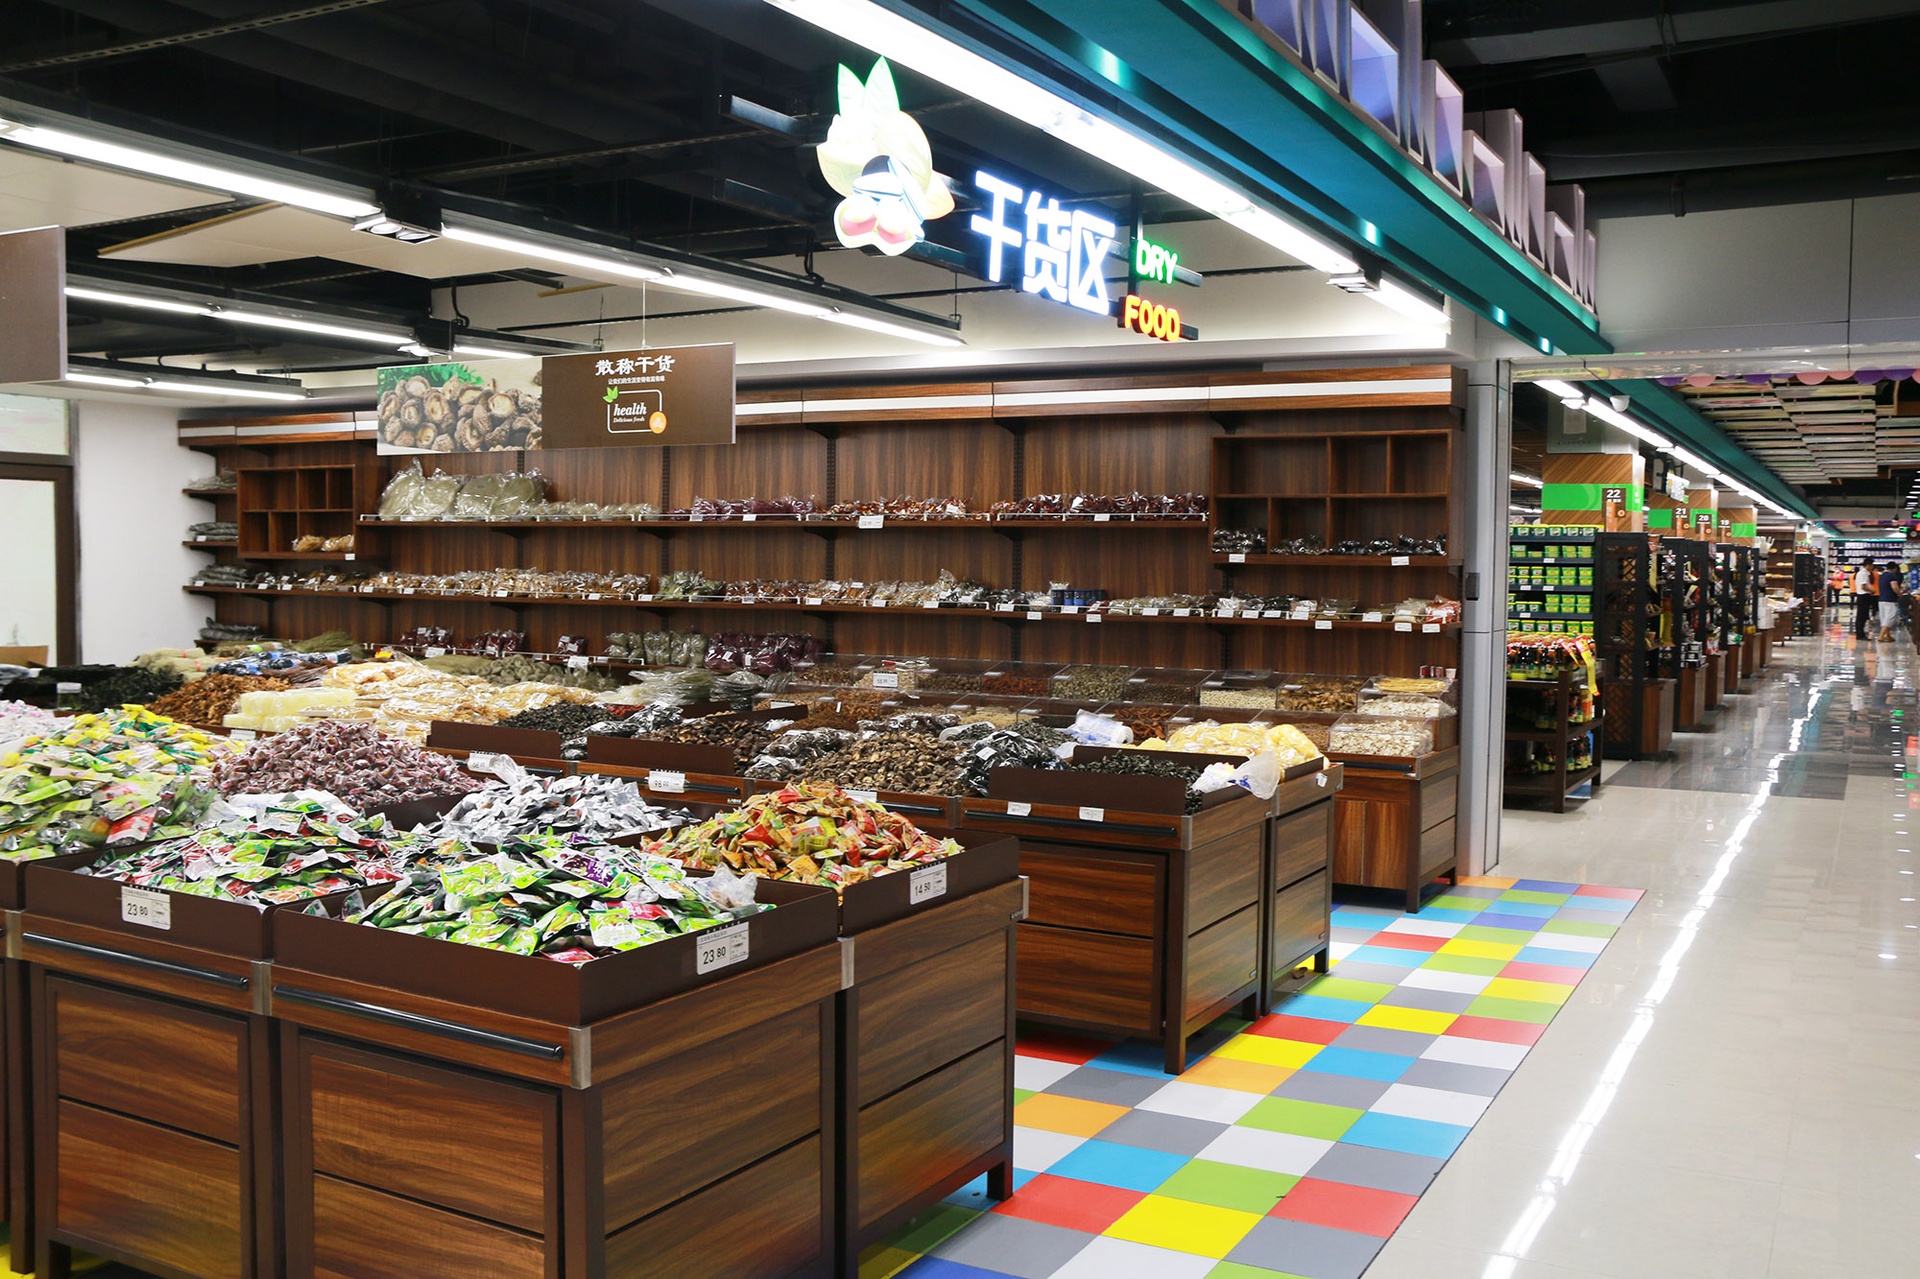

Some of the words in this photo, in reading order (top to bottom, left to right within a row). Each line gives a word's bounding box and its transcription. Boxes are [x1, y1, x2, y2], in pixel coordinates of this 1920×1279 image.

[970, 169, 1117, 316] 干货区
[1135, 238, 1179, 285] DRY
[1123, 294, 1181, 342] FOOD
[595, 354, 676, 376] 散称干货
[613, 402, 647, 416] health
[1606, 489, 1621, 498] 22
[127, 902, 138, 916] 23
[703, 949, 715, 965] 23
[716, 946, 727, 958] 80
